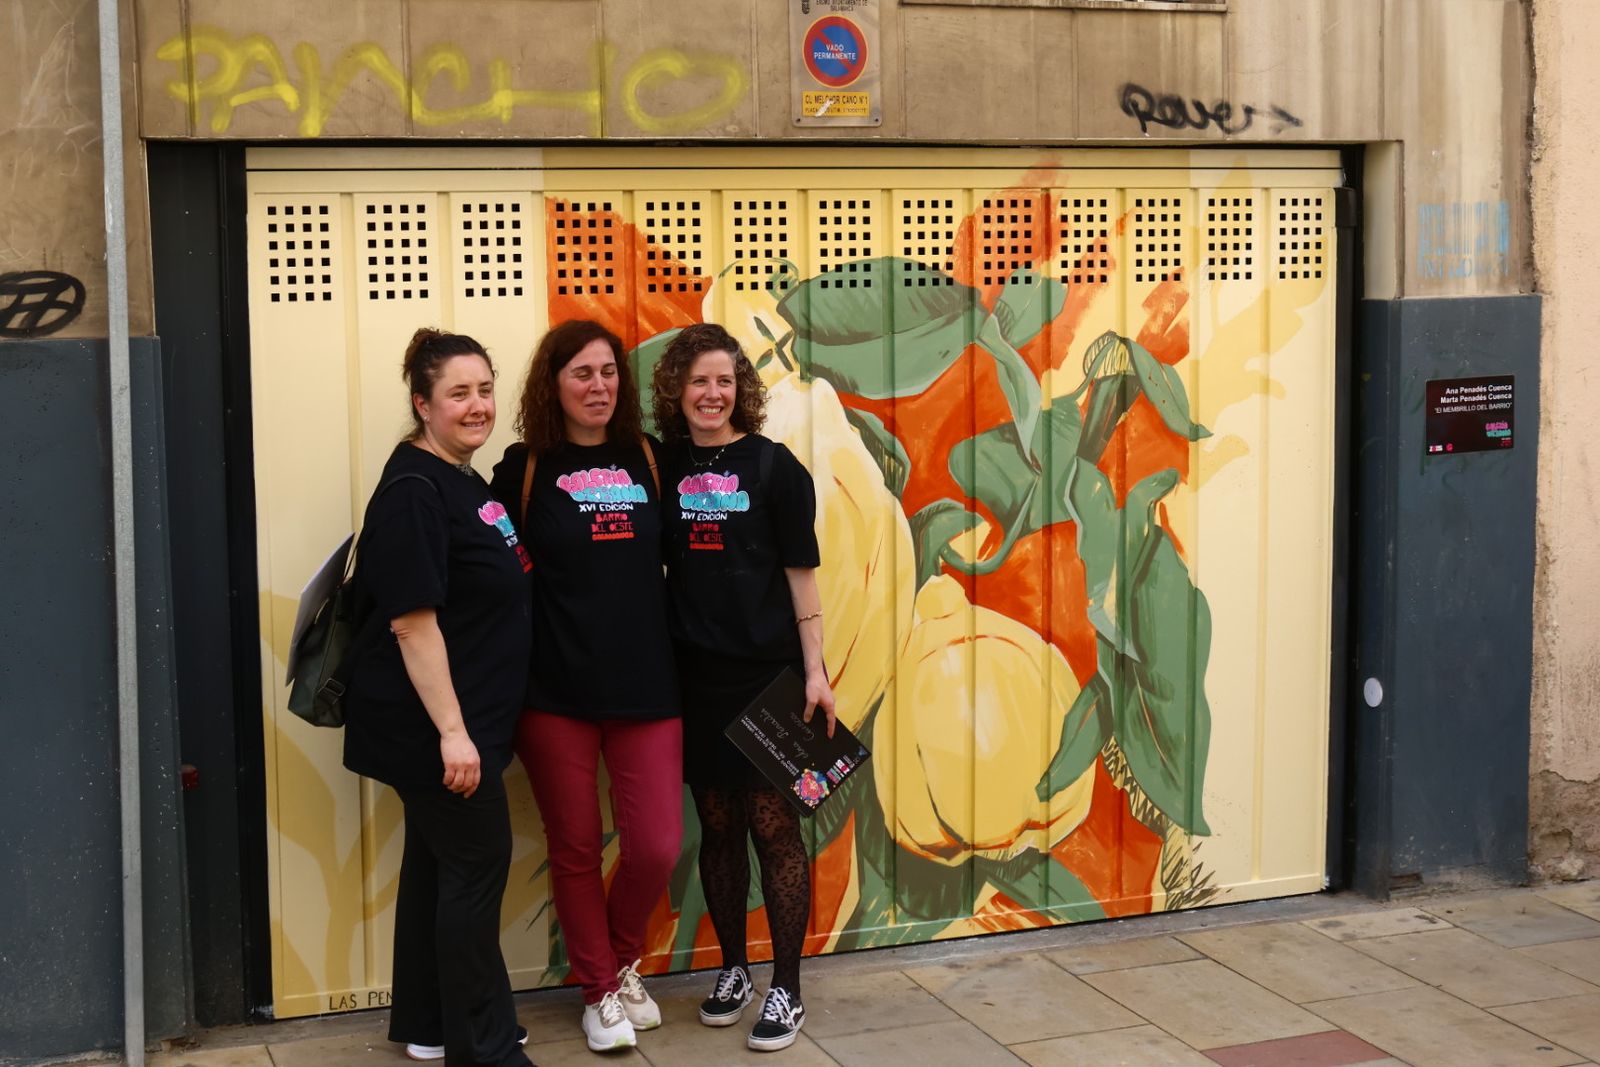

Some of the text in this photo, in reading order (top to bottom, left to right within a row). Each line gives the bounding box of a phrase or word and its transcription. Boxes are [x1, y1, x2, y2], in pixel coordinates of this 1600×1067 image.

[813, 52, 857, 60] PERMANENTE
[842, 95, 857, 104] CANO
[579, 502, 634, 513] XVI EDICIÓN
[681, 510, 728, 521] XVI EDICIÓN
[329, 994, 357, 1010] LAS
